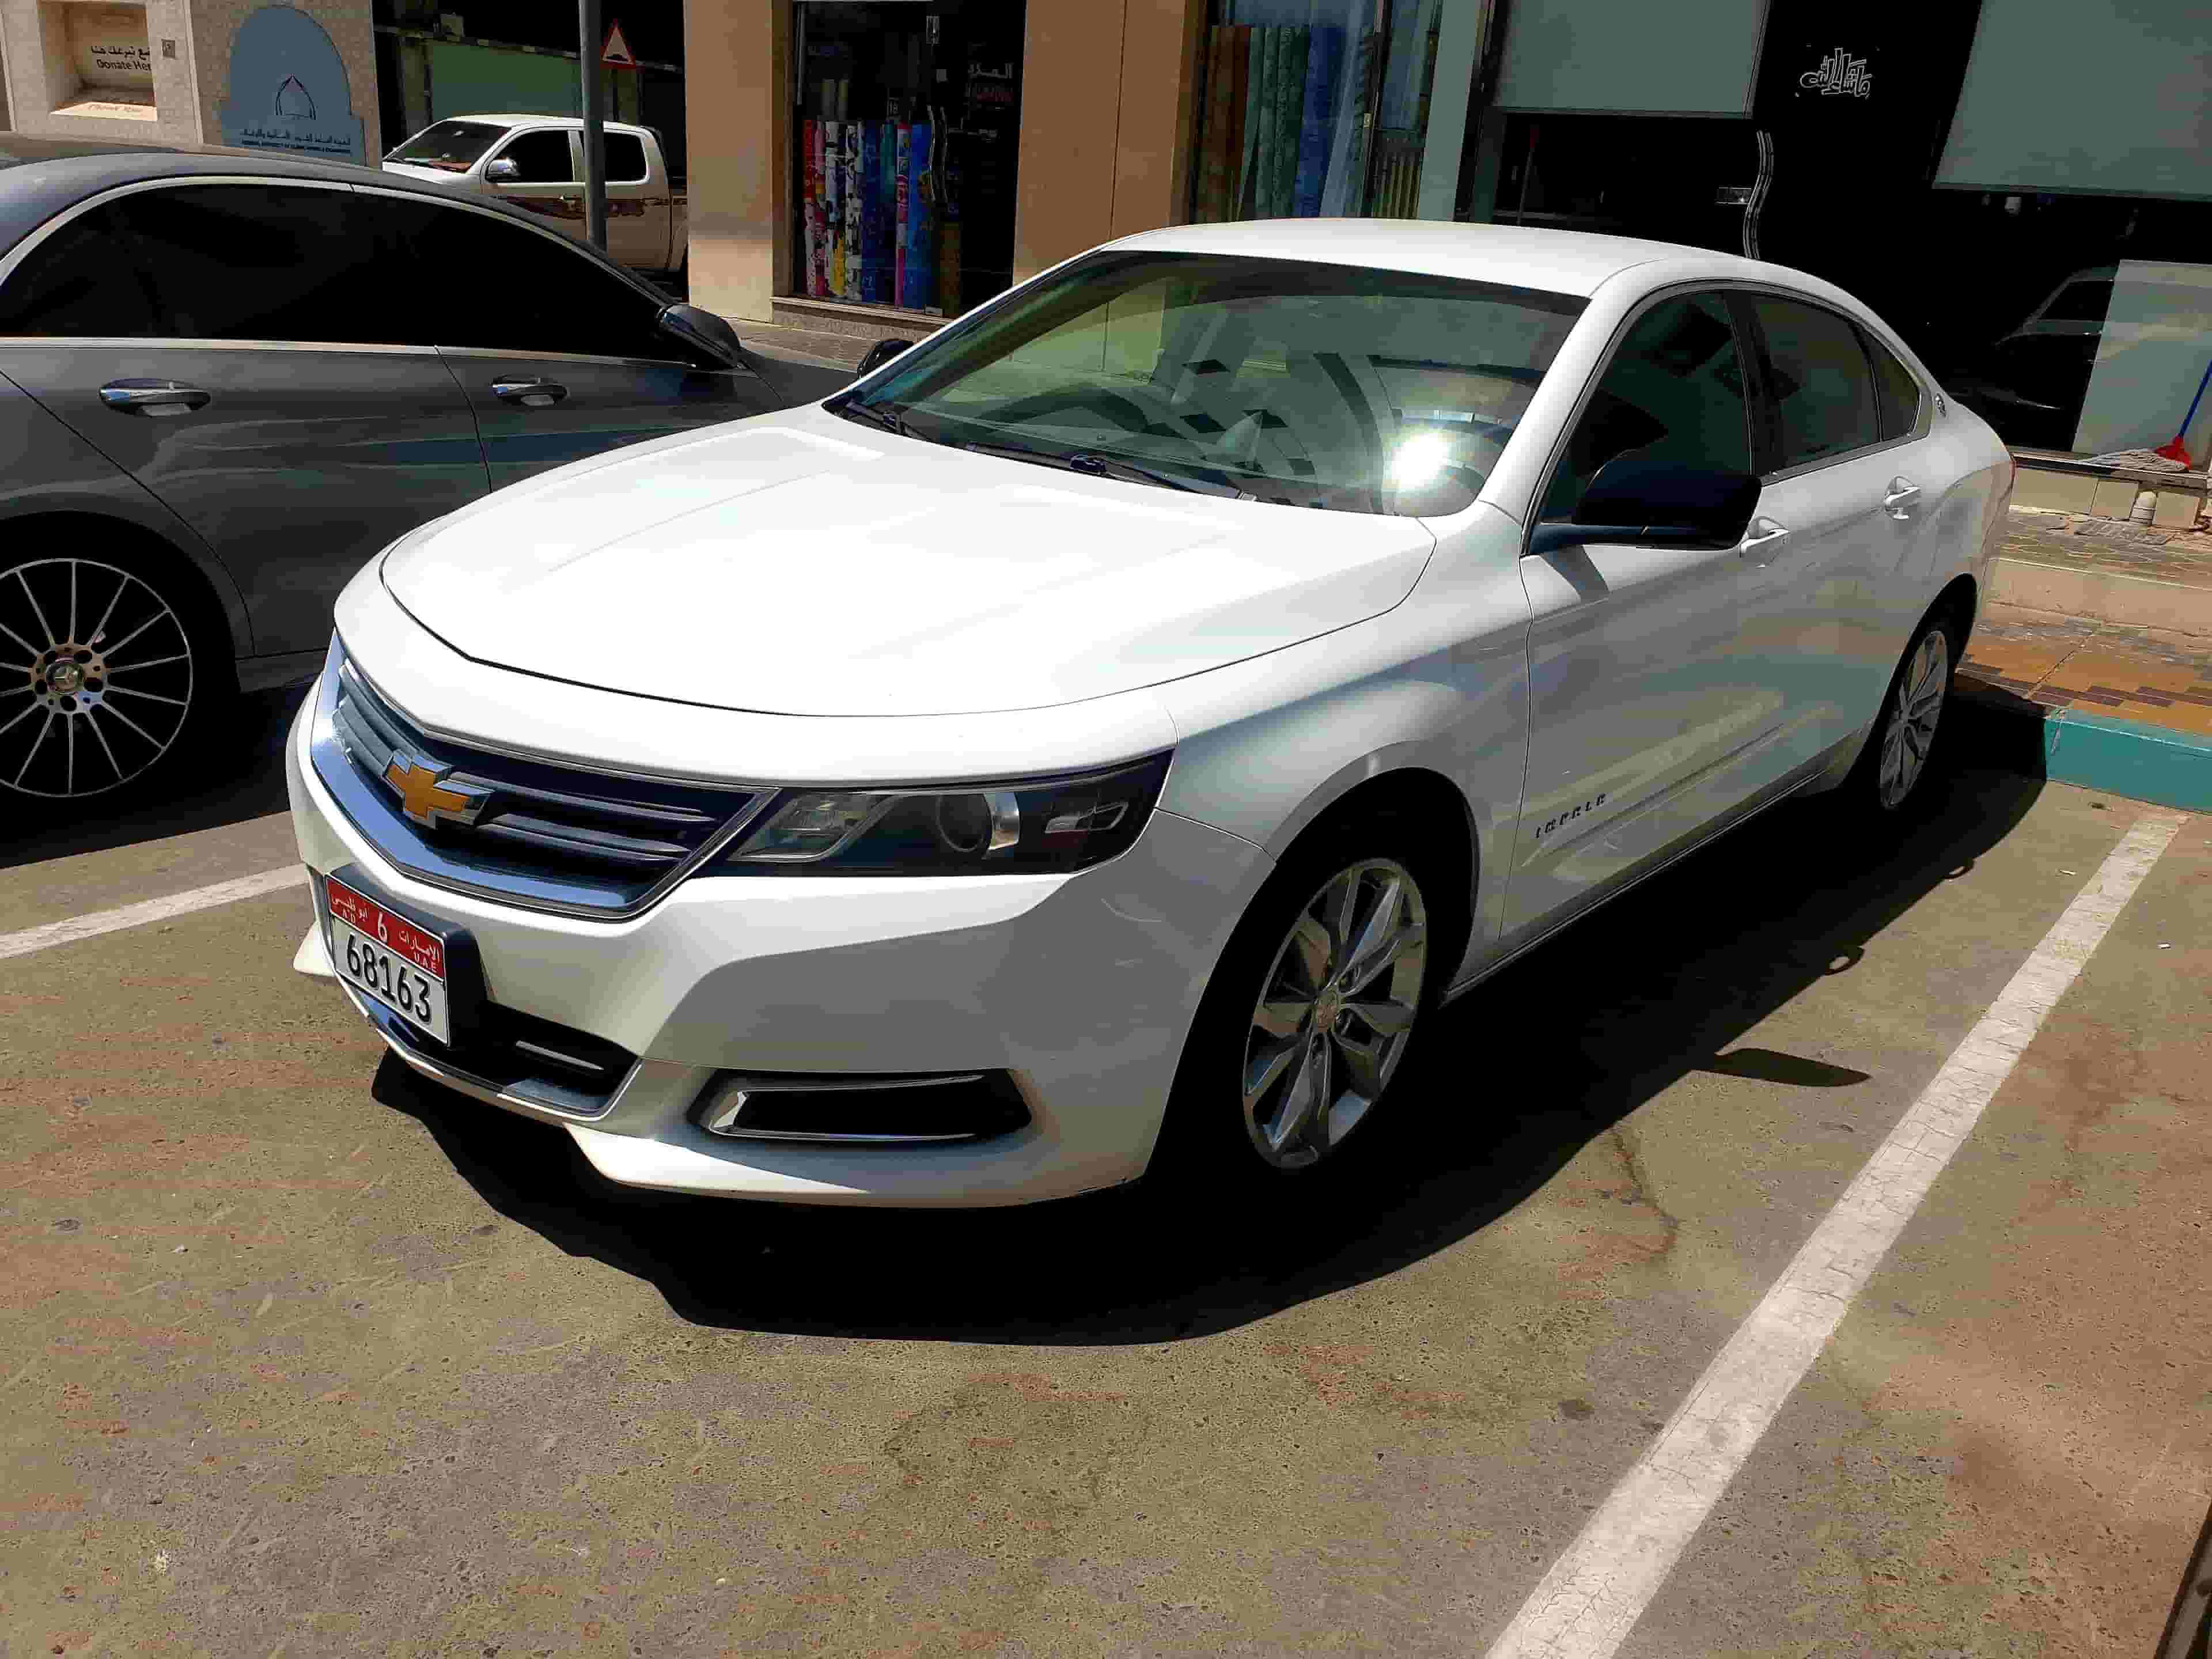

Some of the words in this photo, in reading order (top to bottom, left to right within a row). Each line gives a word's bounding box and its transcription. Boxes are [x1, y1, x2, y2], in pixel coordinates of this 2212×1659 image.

[96, 59, 132, 70] Donate
[1536, 793, 1606, 839] IMPALA
[378, 911, 388, 943] 6
[347, 932, 431, 1024] 68163
